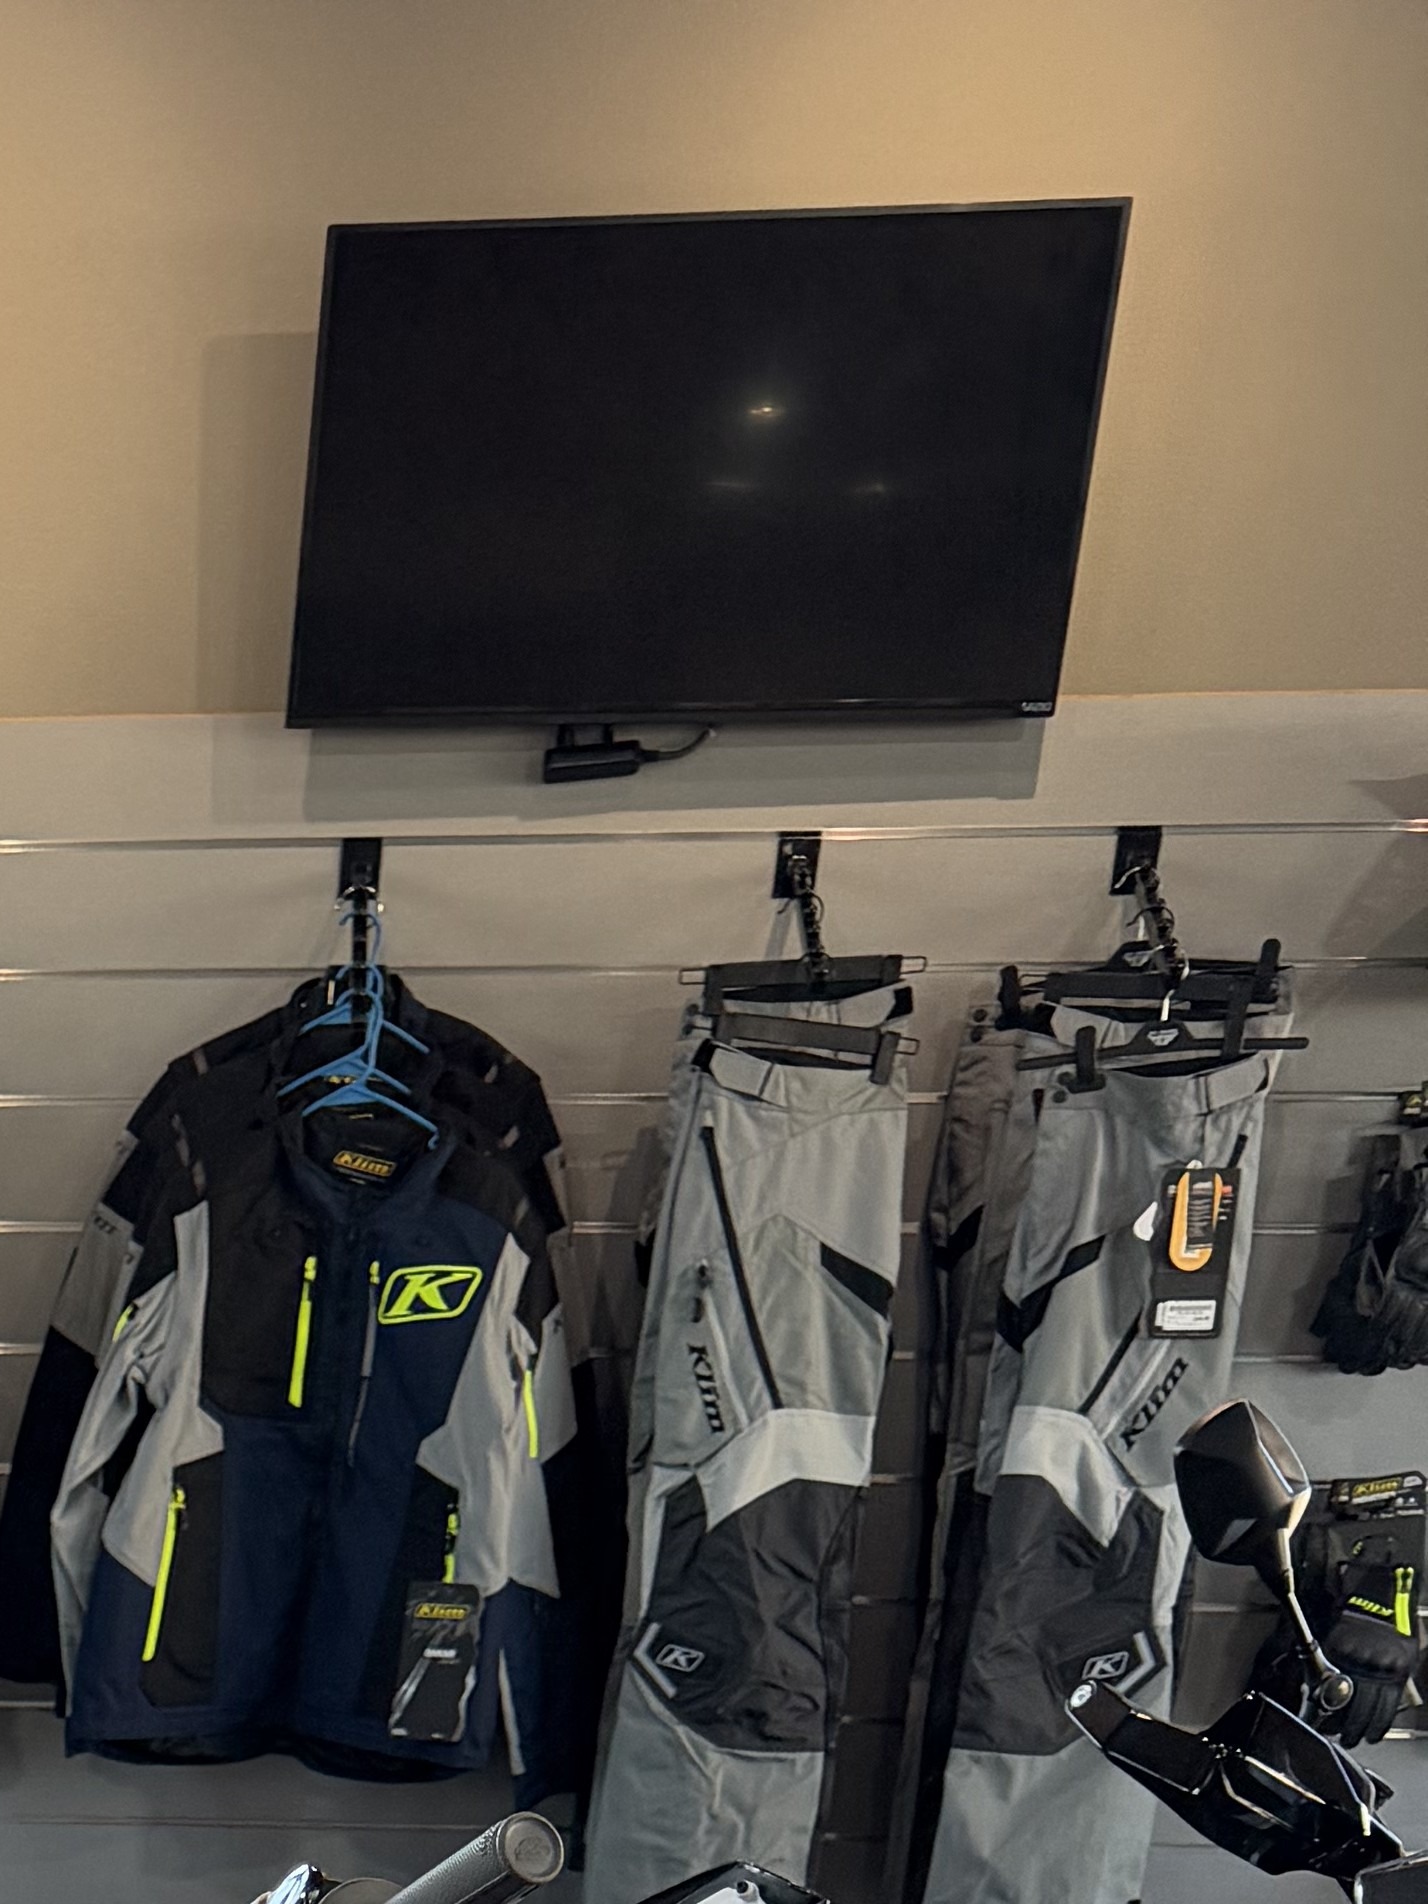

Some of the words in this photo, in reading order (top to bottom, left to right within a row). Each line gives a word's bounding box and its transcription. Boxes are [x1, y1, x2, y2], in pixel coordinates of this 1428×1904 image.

[337, 1151, 393, 1177] Klim
[687, 1343, 726, 1435] Klim
[1119, 1356, 1189, 1453] Klim
